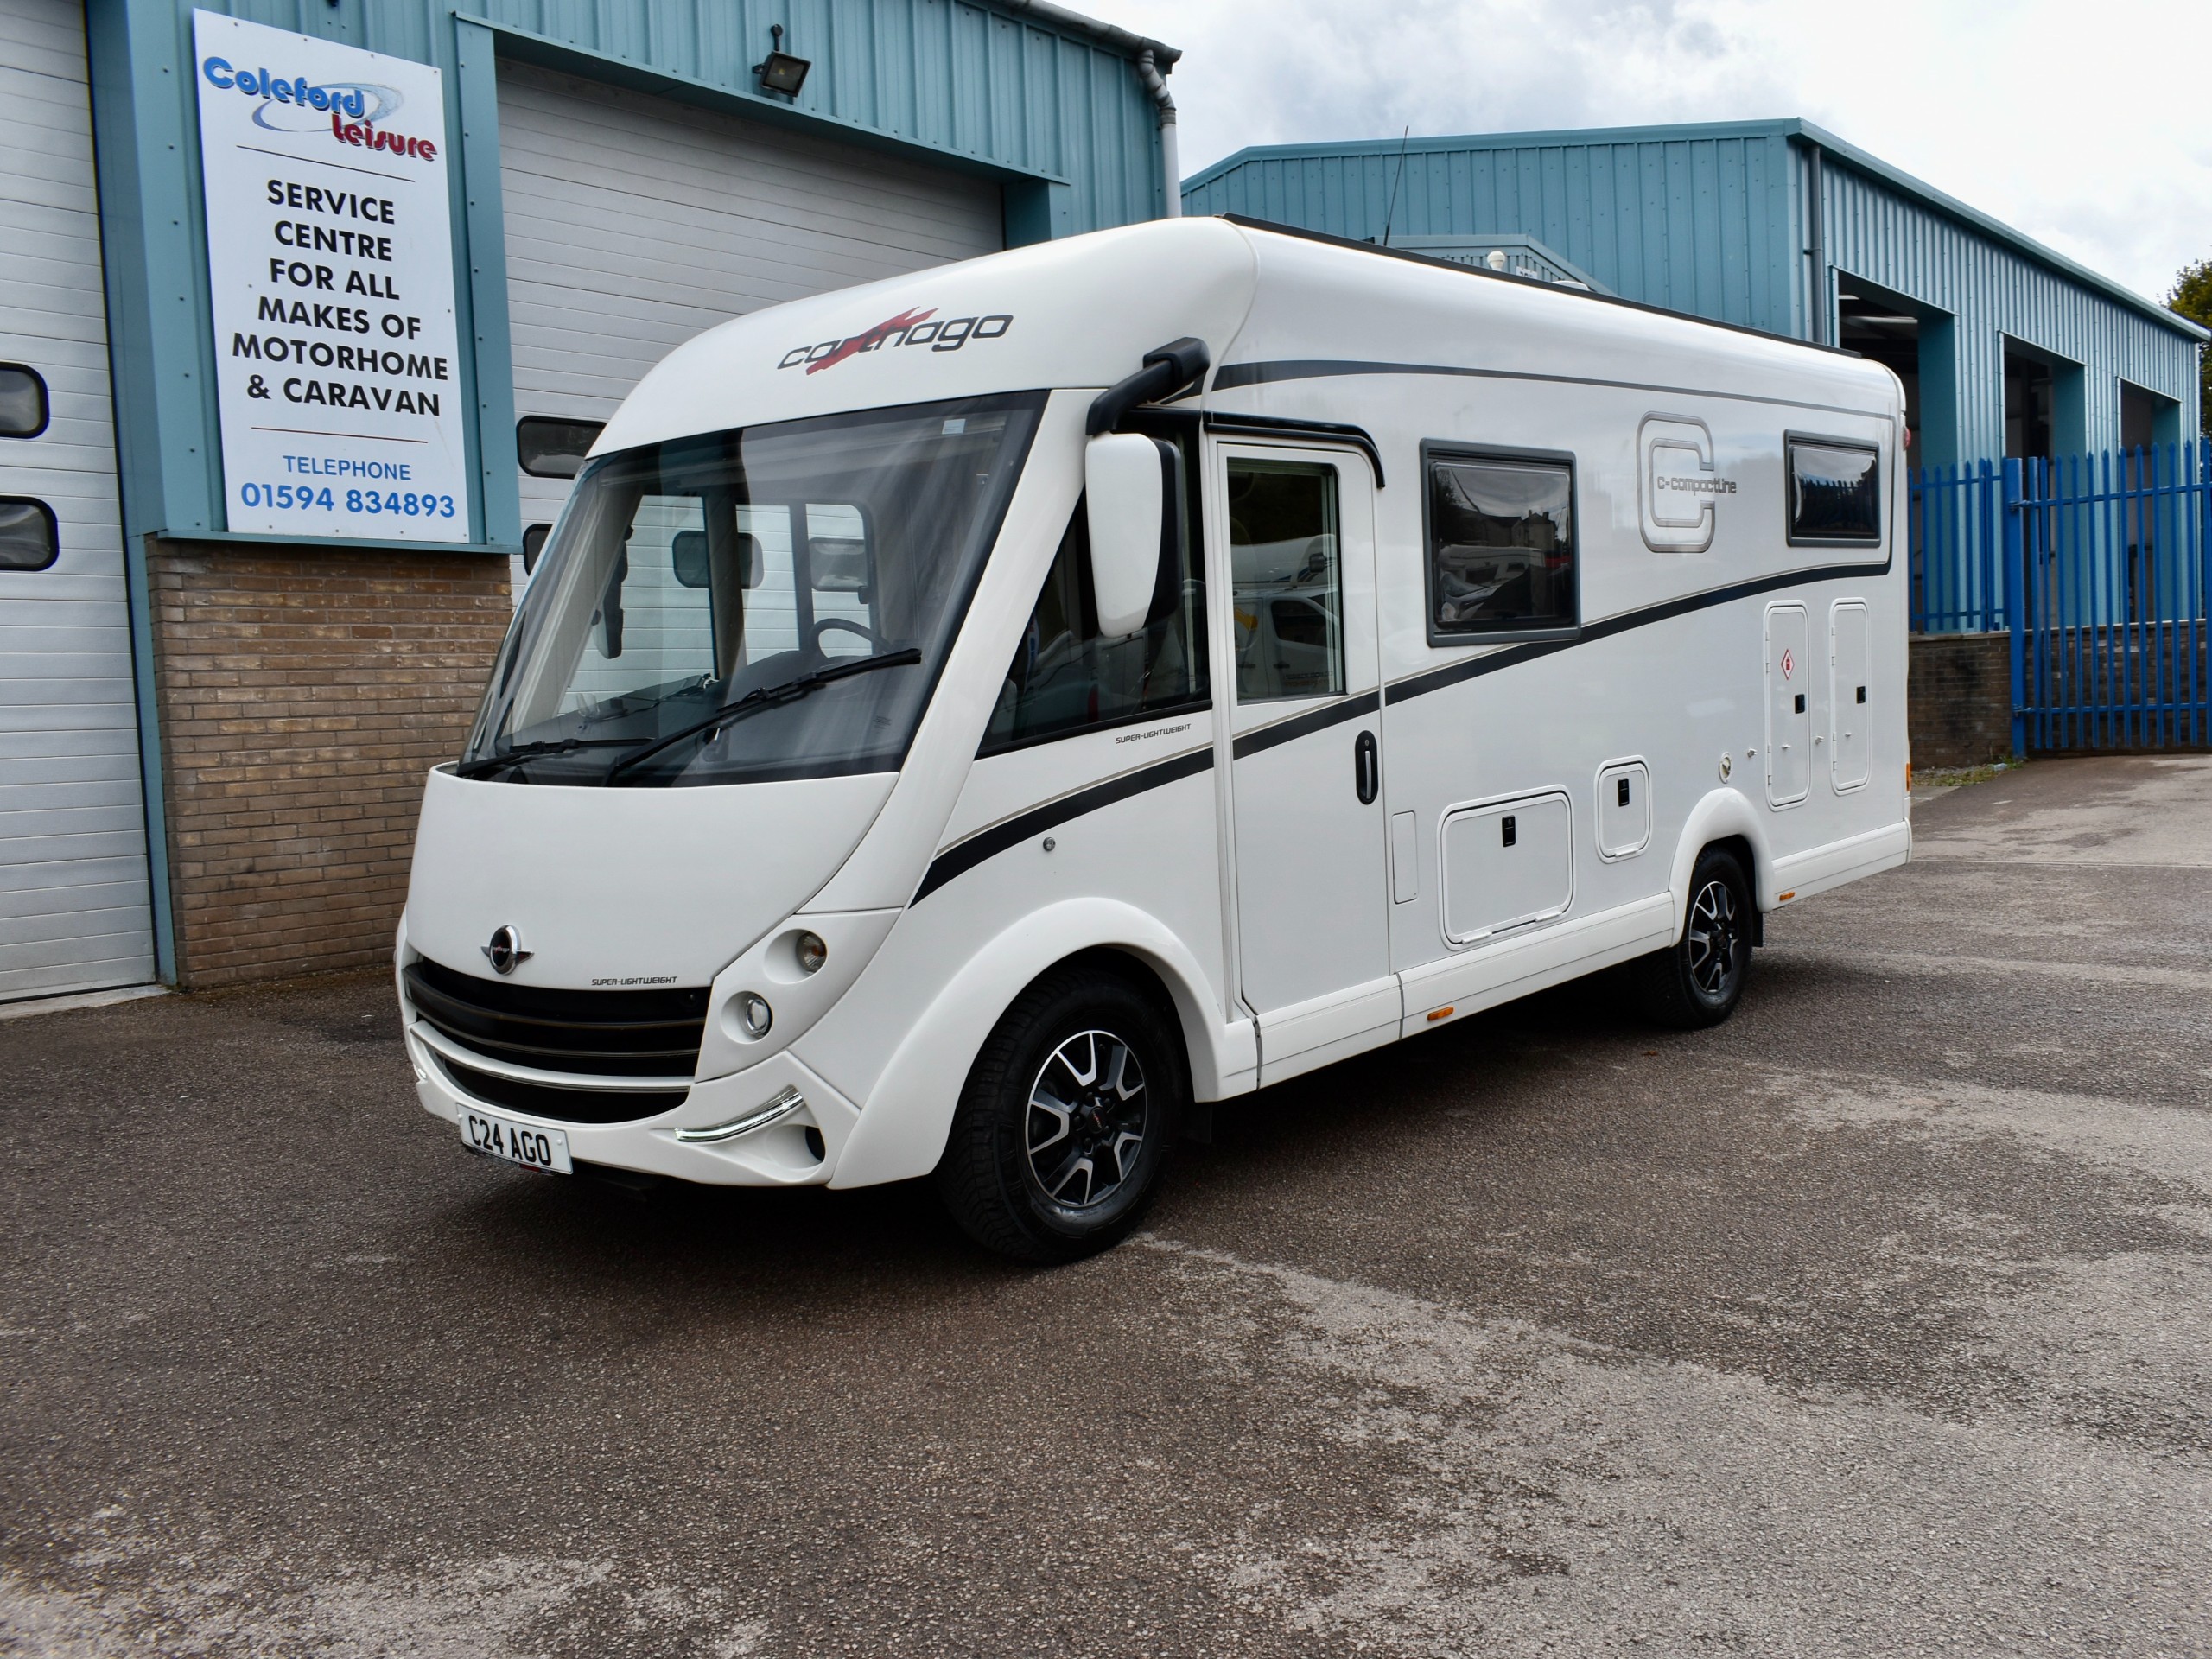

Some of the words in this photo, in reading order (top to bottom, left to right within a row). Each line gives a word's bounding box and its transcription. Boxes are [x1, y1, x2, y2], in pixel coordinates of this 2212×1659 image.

[203, 56, 365, 118] Coleford
[267, 179, 395, 225] SERVICE
[274, 220, 392, 262] CENTRE
[270, 258, 335, 291] FOR
[345, 270, 400, 301] ALL
[257, 296, 371, 334] MAKES
[381, 314, 421, 340] OF
[232, 333, 448, 380] MOTORHOME
[246, 374, 271, 399] &
[283, 378, 441, 416] CARAVAN
[283, 455, 412, 480] TELEPHONE
[1657, 476, 1737, 497] c-compactline
[241, 482, 335, 512] 01594
[346, 489, 455, 518] 834893
[1116, 724, 1191, 744] SUPER-LIGHTWEIGHT
[591, 976, 677, 986] SUPER-LIGHTWEIGHT
[468, 1115, 504, 1154] C24
[510, 1128, 552, 1166] AGO
